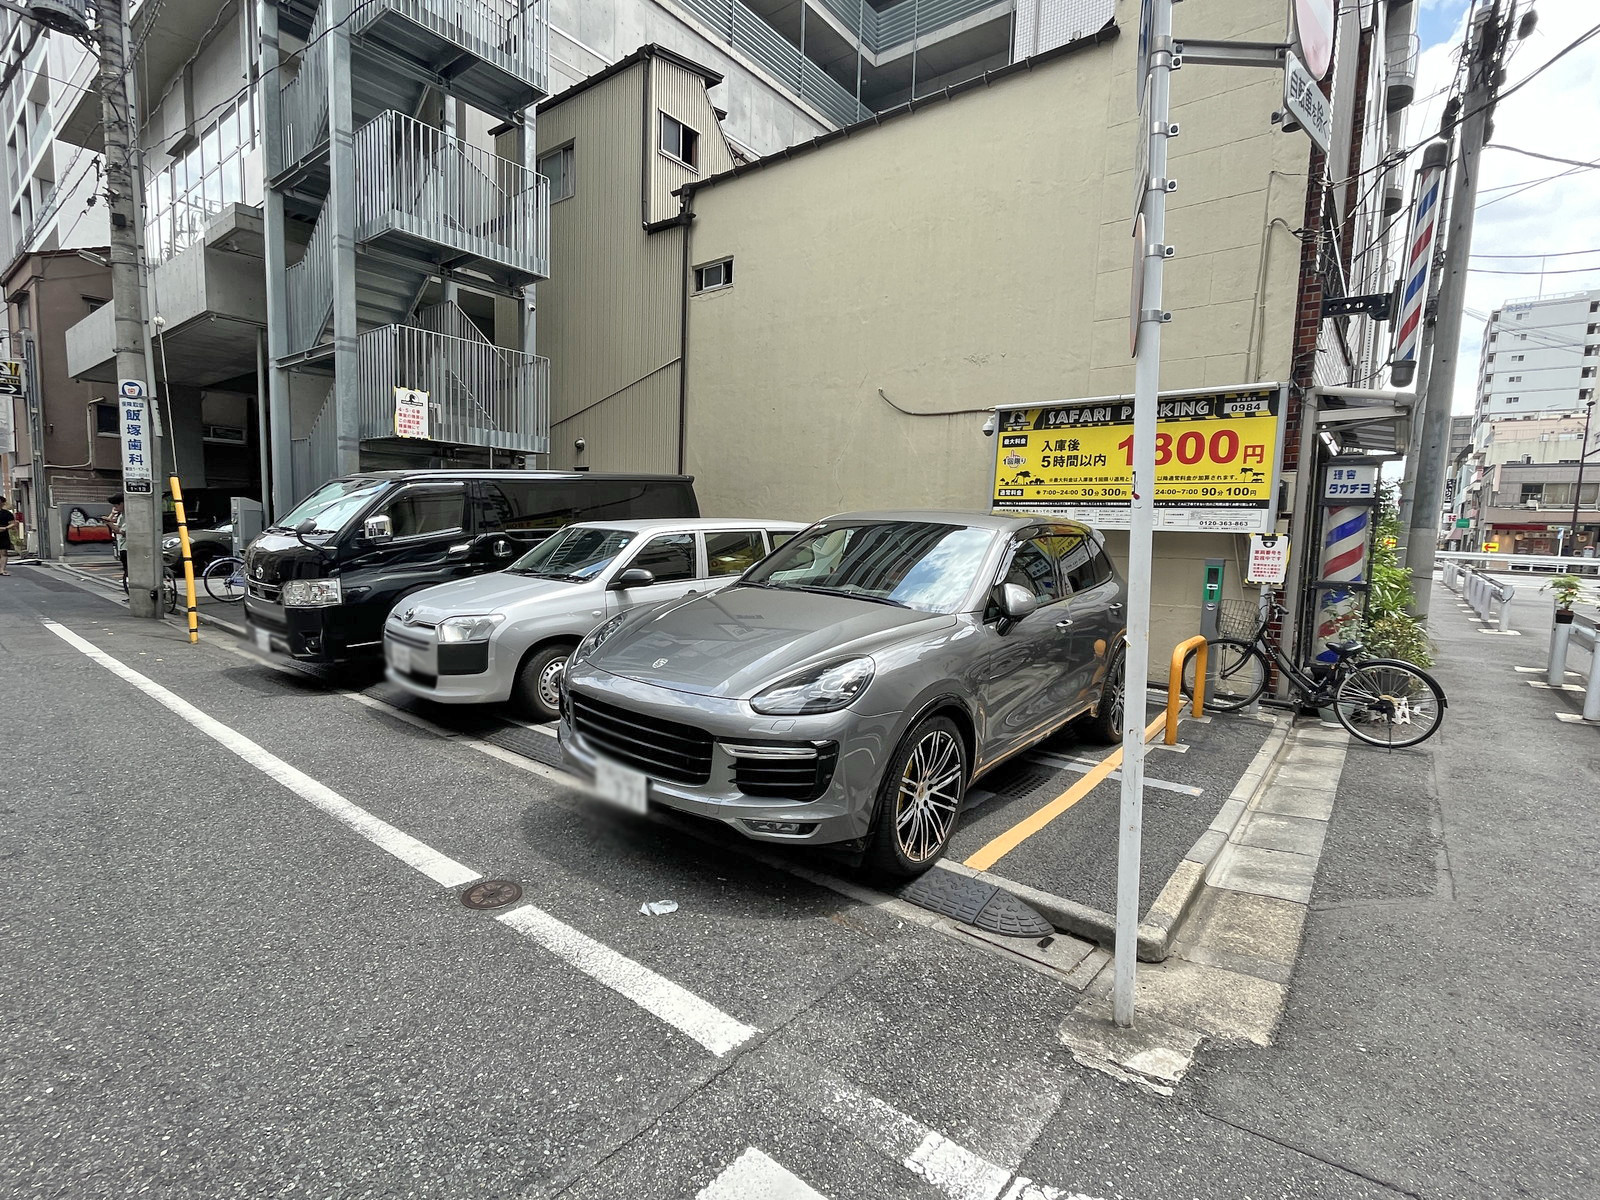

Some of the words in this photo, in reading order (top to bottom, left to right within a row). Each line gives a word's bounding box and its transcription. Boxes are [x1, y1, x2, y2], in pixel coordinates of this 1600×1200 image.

[1290, 70, 1327, 139] 自転車を除く
[1048, 407, 1112, 425] SAFARI
[1120, 401, 1210, 420] PKING
[1231, 402, 1261, 412] 0984
[126, 409, 144, 466] 飯塚歯科
[1003, 437, 1027, 446] 最大料金
[1041, 438, 1081, 453] 入庫後
[1041, 454, 1107, 469] 5時間以内
[1333, 470, 1357, 480] 理容
[1328, 483, 1371, 495] タカチヨ
